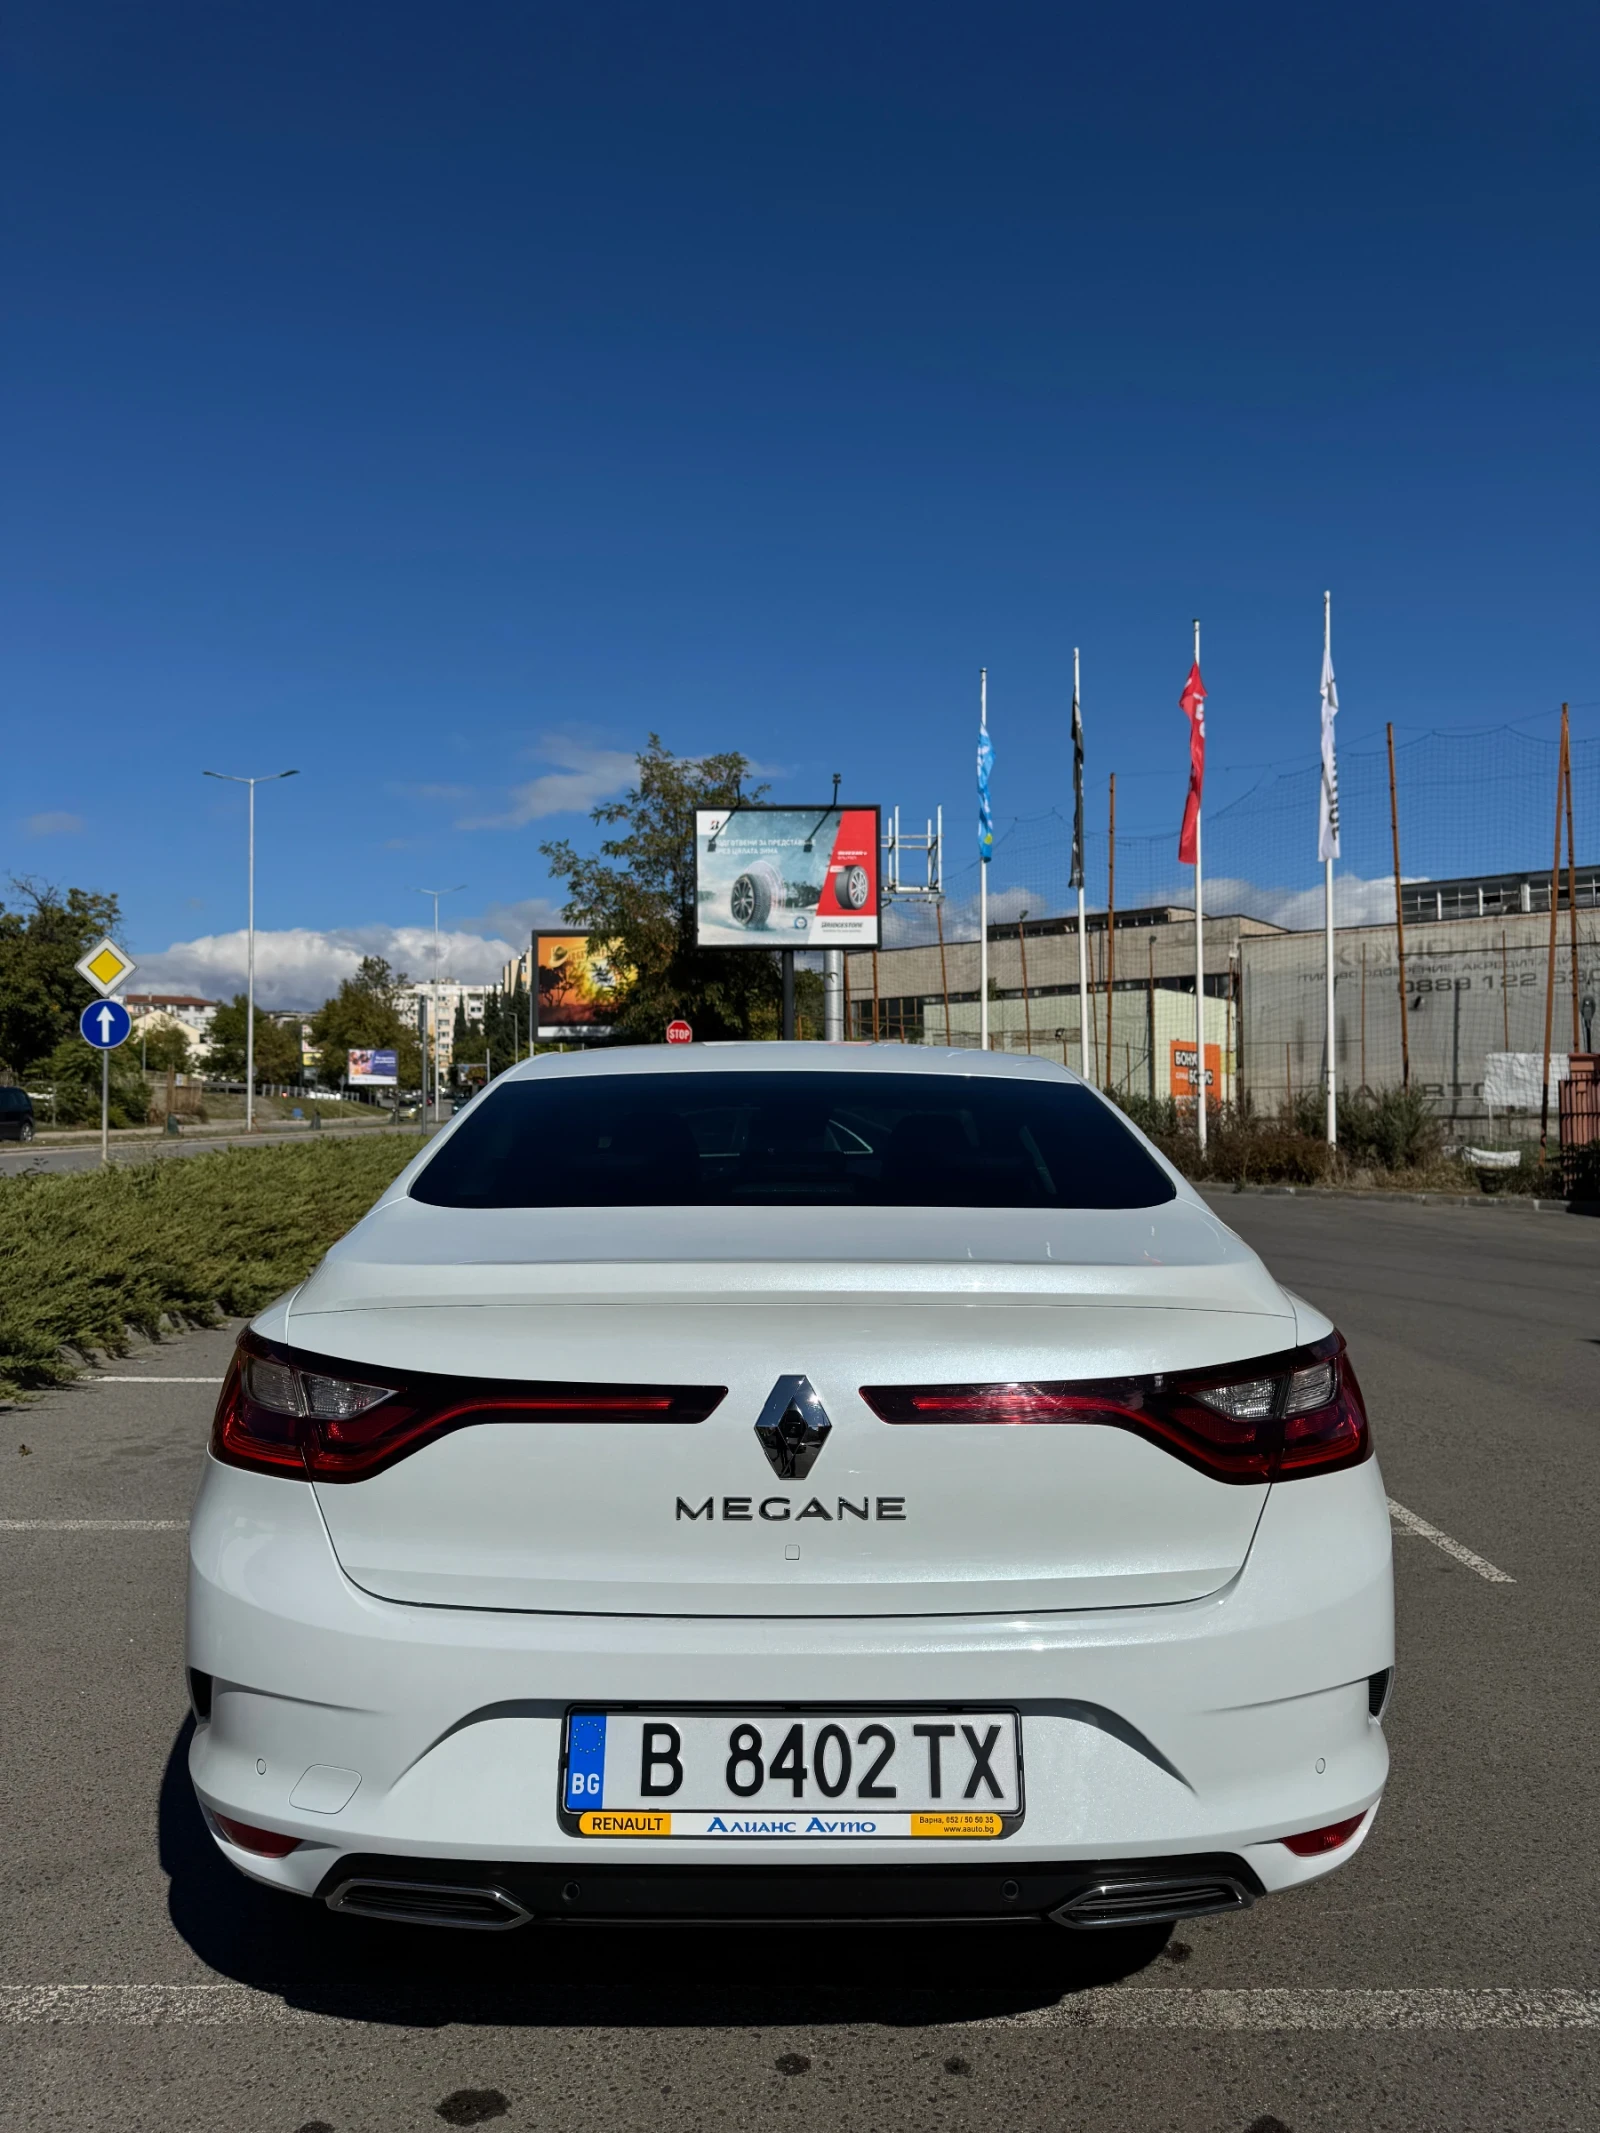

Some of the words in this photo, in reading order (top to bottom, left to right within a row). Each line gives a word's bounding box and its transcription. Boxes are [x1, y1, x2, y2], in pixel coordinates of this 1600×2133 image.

[1482, 972, 1537, 989] 122
[669, 1029, 690, 1040] STOP
[675, 1496, 907, 1521] MEGANE
[640, 1723, 683, 1797] B
[726, 1723, 897, 1798] 8402
[914, 1725, 1005, 1799] TX
[572, 1772, 600, 1795] BG
[592, 1817, 664, 1831] RENAULT
[919, 1816, 945, 1825] Варна,
[946, 1816, 959, 1824] 052
[964, 1816, 974, 1824] 50
[975, 1816, 984, 1824] 50
[985, 1816, 994, 1824] 35
[944, 1826, 995, 1835] www.aauto.bg
